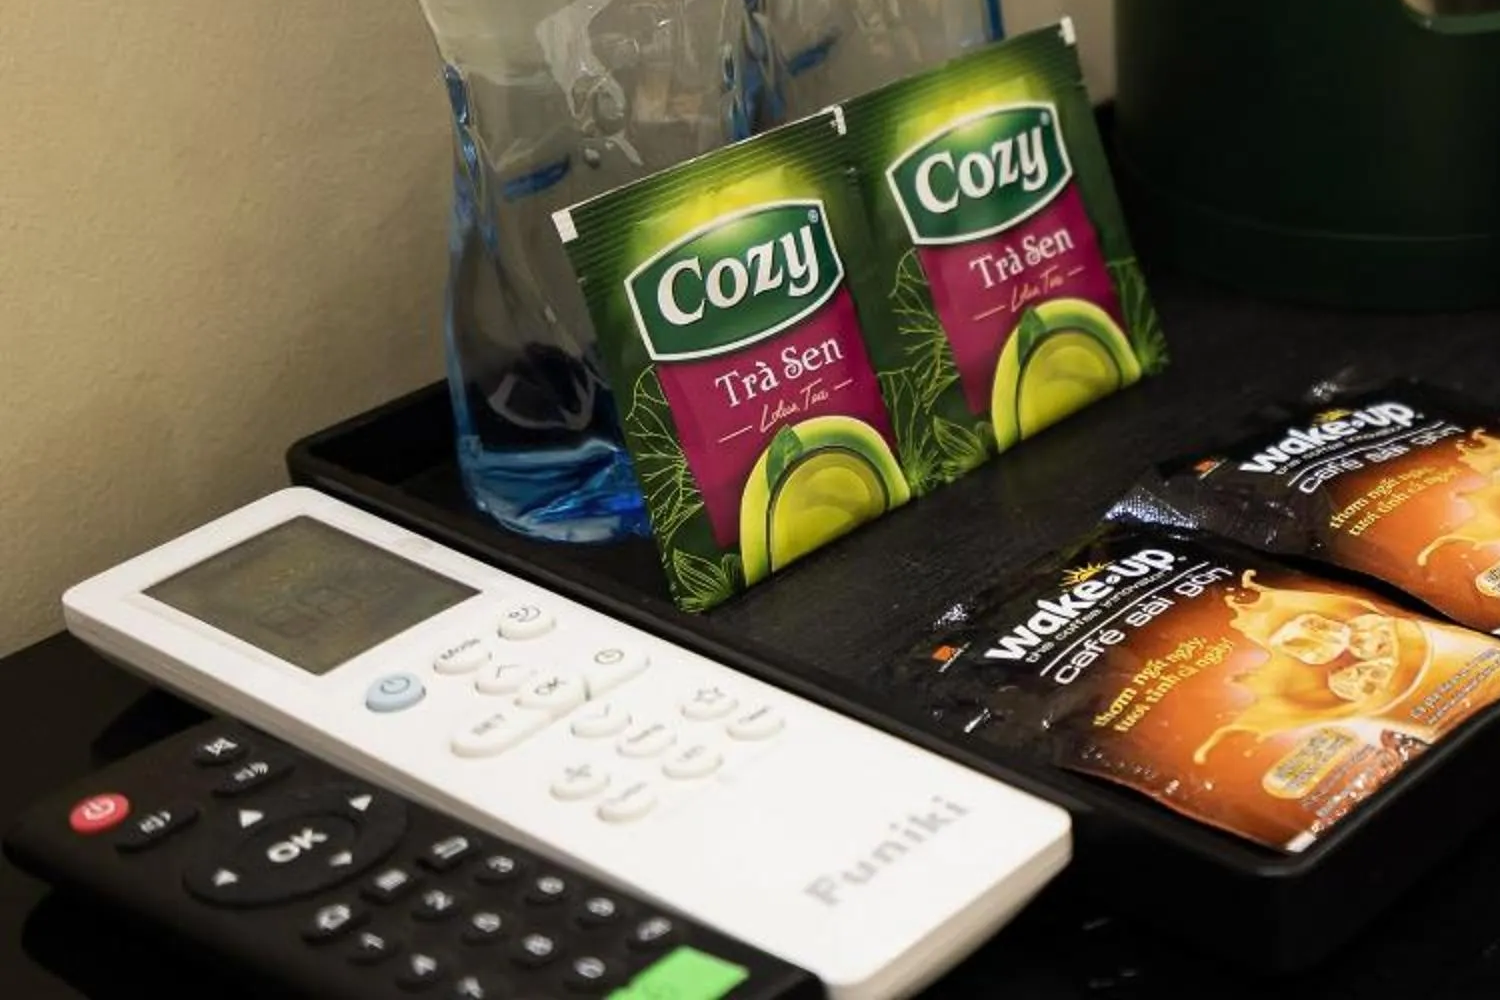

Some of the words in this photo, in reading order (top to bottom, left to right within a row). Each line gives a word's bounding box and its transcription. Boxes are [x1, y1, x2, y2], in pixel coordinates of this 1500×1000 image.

[915, 125, 1050, 214] Cozy
[657, 224, 820, 326] Cozy
[969, 246, 1024, 289] Trà
[1022, 227, 1075, 266] Sen
[715, 360, 778, 408] Trà
[781, 337, 844, 380] Sen
[1054, 625, 1126, 685] café
[1125, 594, 1177, 628] sài
[1173, 565, 1234, 598] gòn
[533, 674, 567, 698] OK
[1093, 687, 1137, 727] thơm
[265, 824, 330, 865] OK
